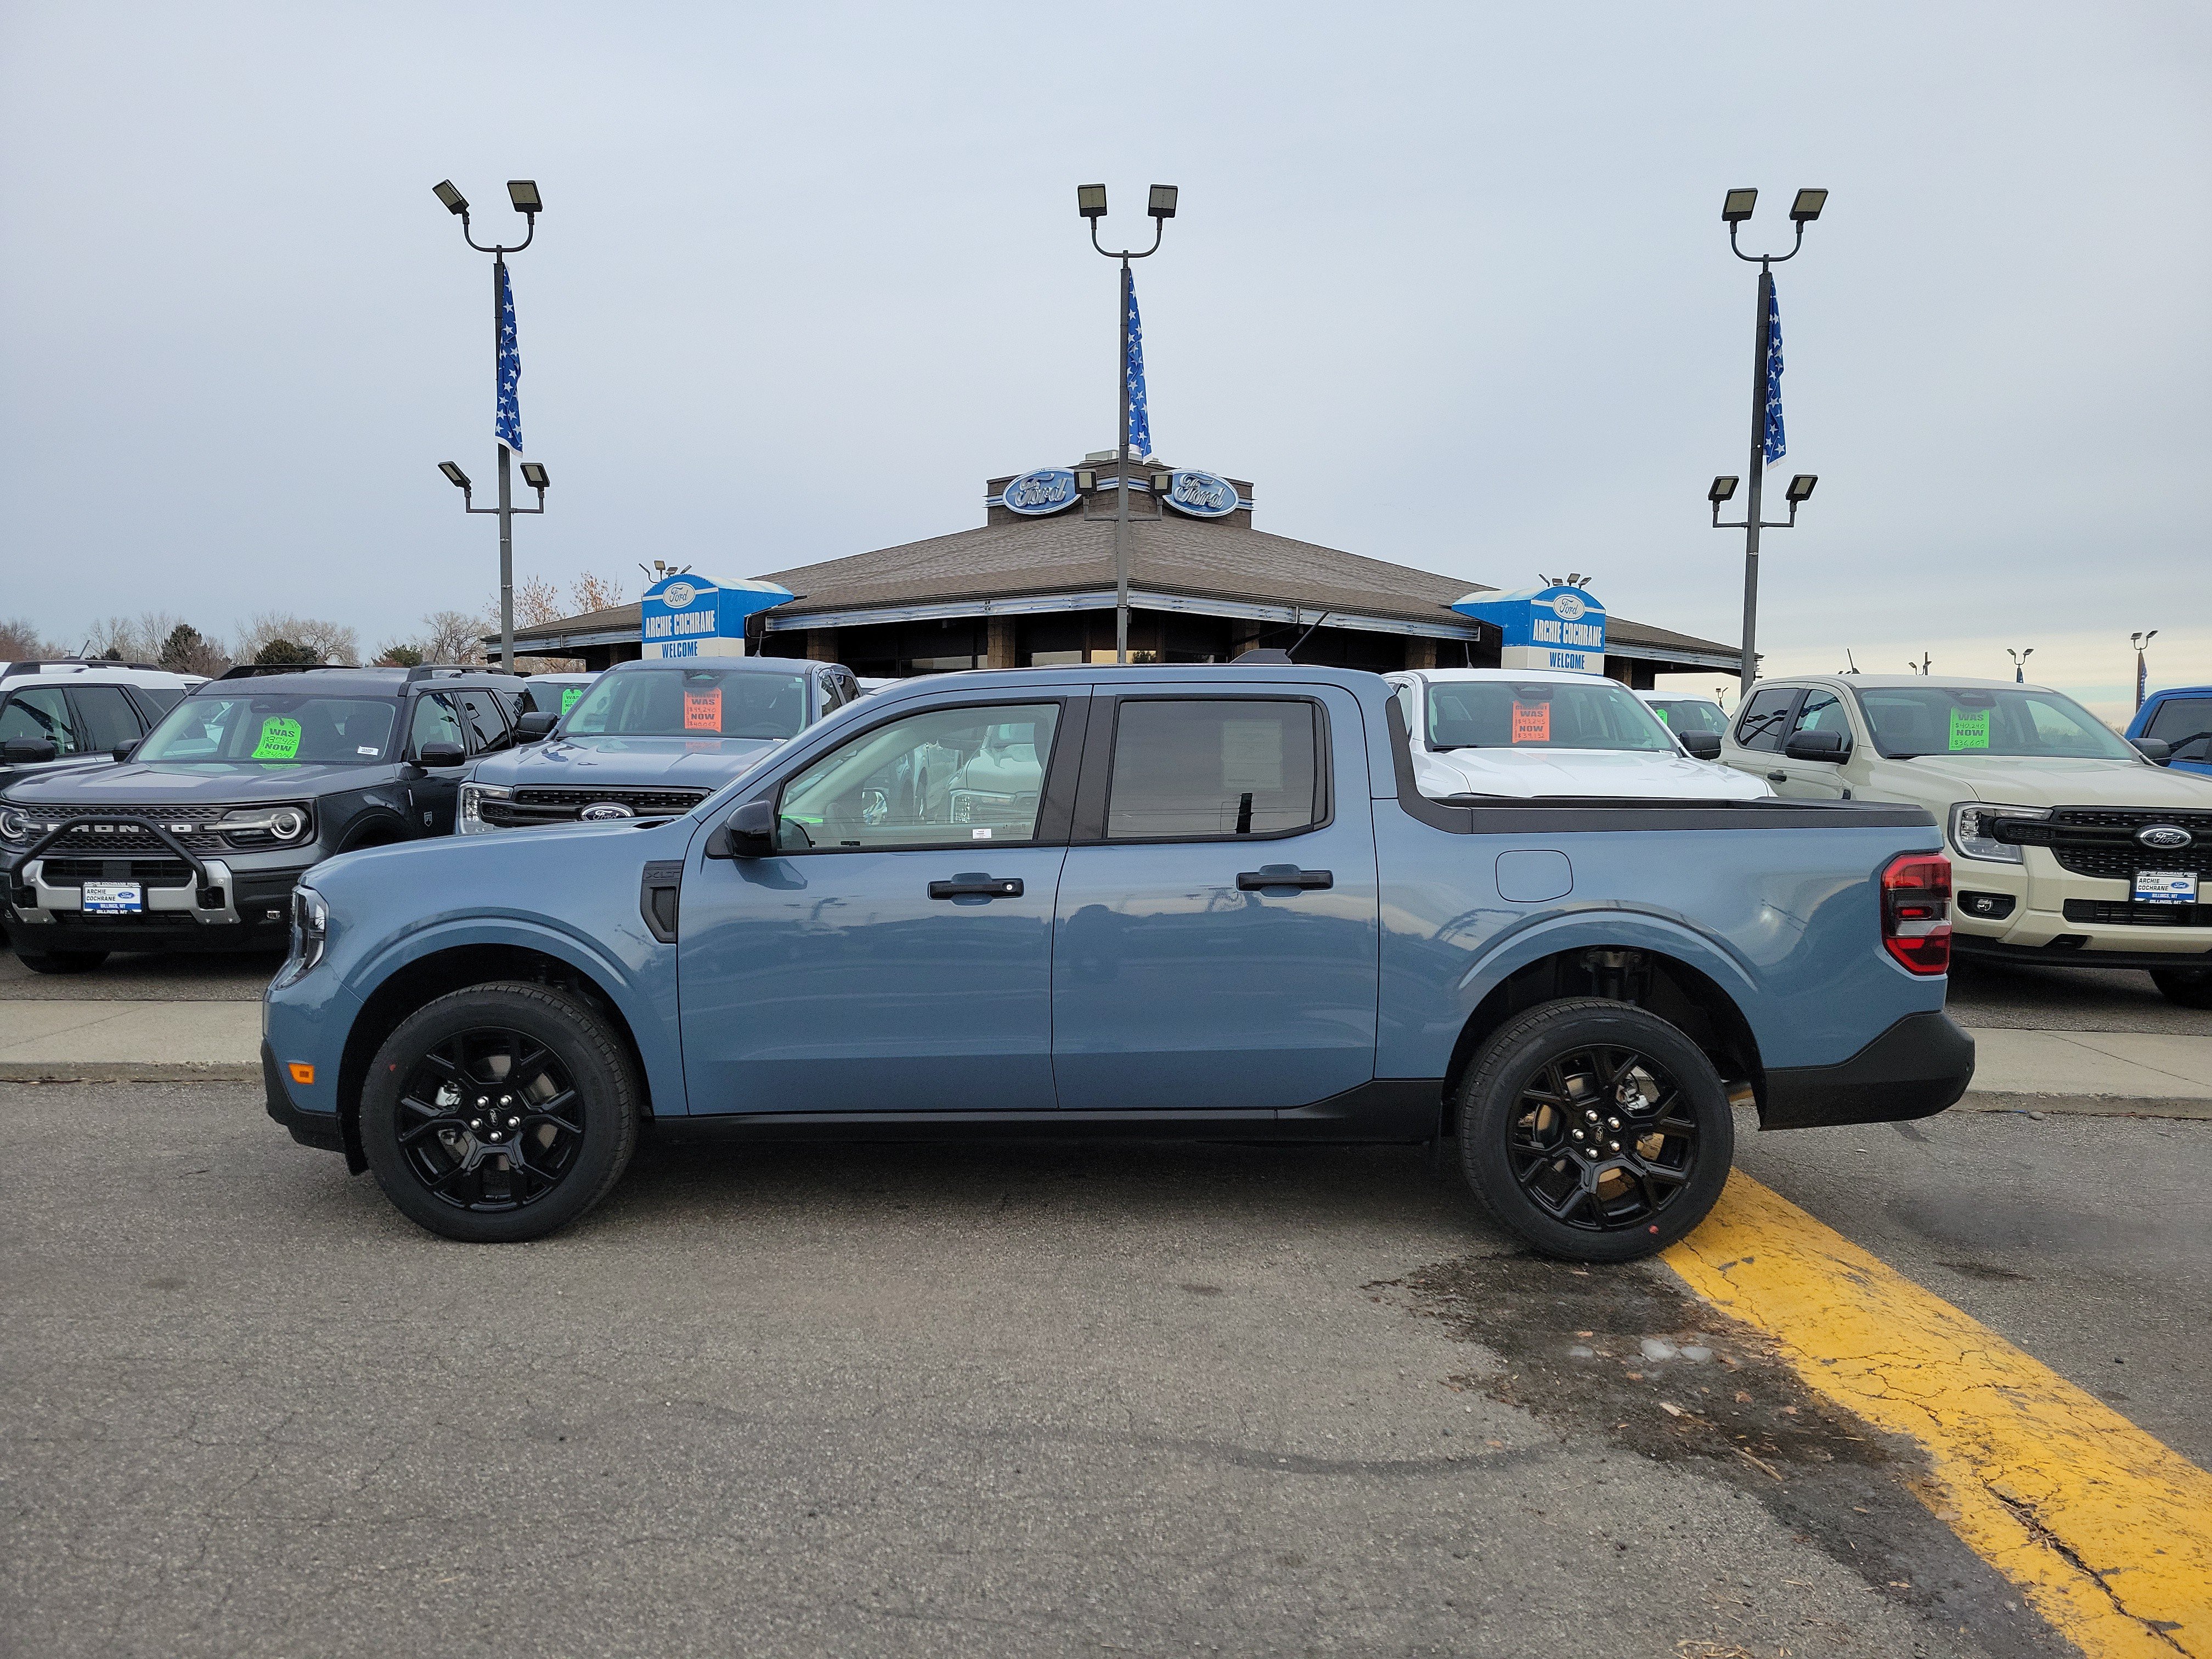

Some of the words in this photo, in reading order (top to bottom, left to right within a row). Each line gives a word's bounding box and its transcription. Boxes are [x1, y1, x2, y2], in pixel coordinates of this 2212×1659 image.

[1015, 473, 1068, 507] Ford
[1173, 473, 1226, 509] Ford
[669, 587, 689, 602] Ford
[1560, 598, 1579, 615] Ford
[645, 615, 672, 639] ARCHIE
[674, 610, 715, 635] COCHRANE
[1533, 619, 1561, 644] ARCHIE
[1562, 623, 1602, 647] COCHRANE
[662, 641, 698, 659] WELCOME
[1549, 651, 1585, 670] WELCOME
[270, 728, 295, 737] WAS
[264, 743, 292, 752] NOW
[593, 810, 619, 820] Ford
[2153, 832, 2180, 844] Ford
